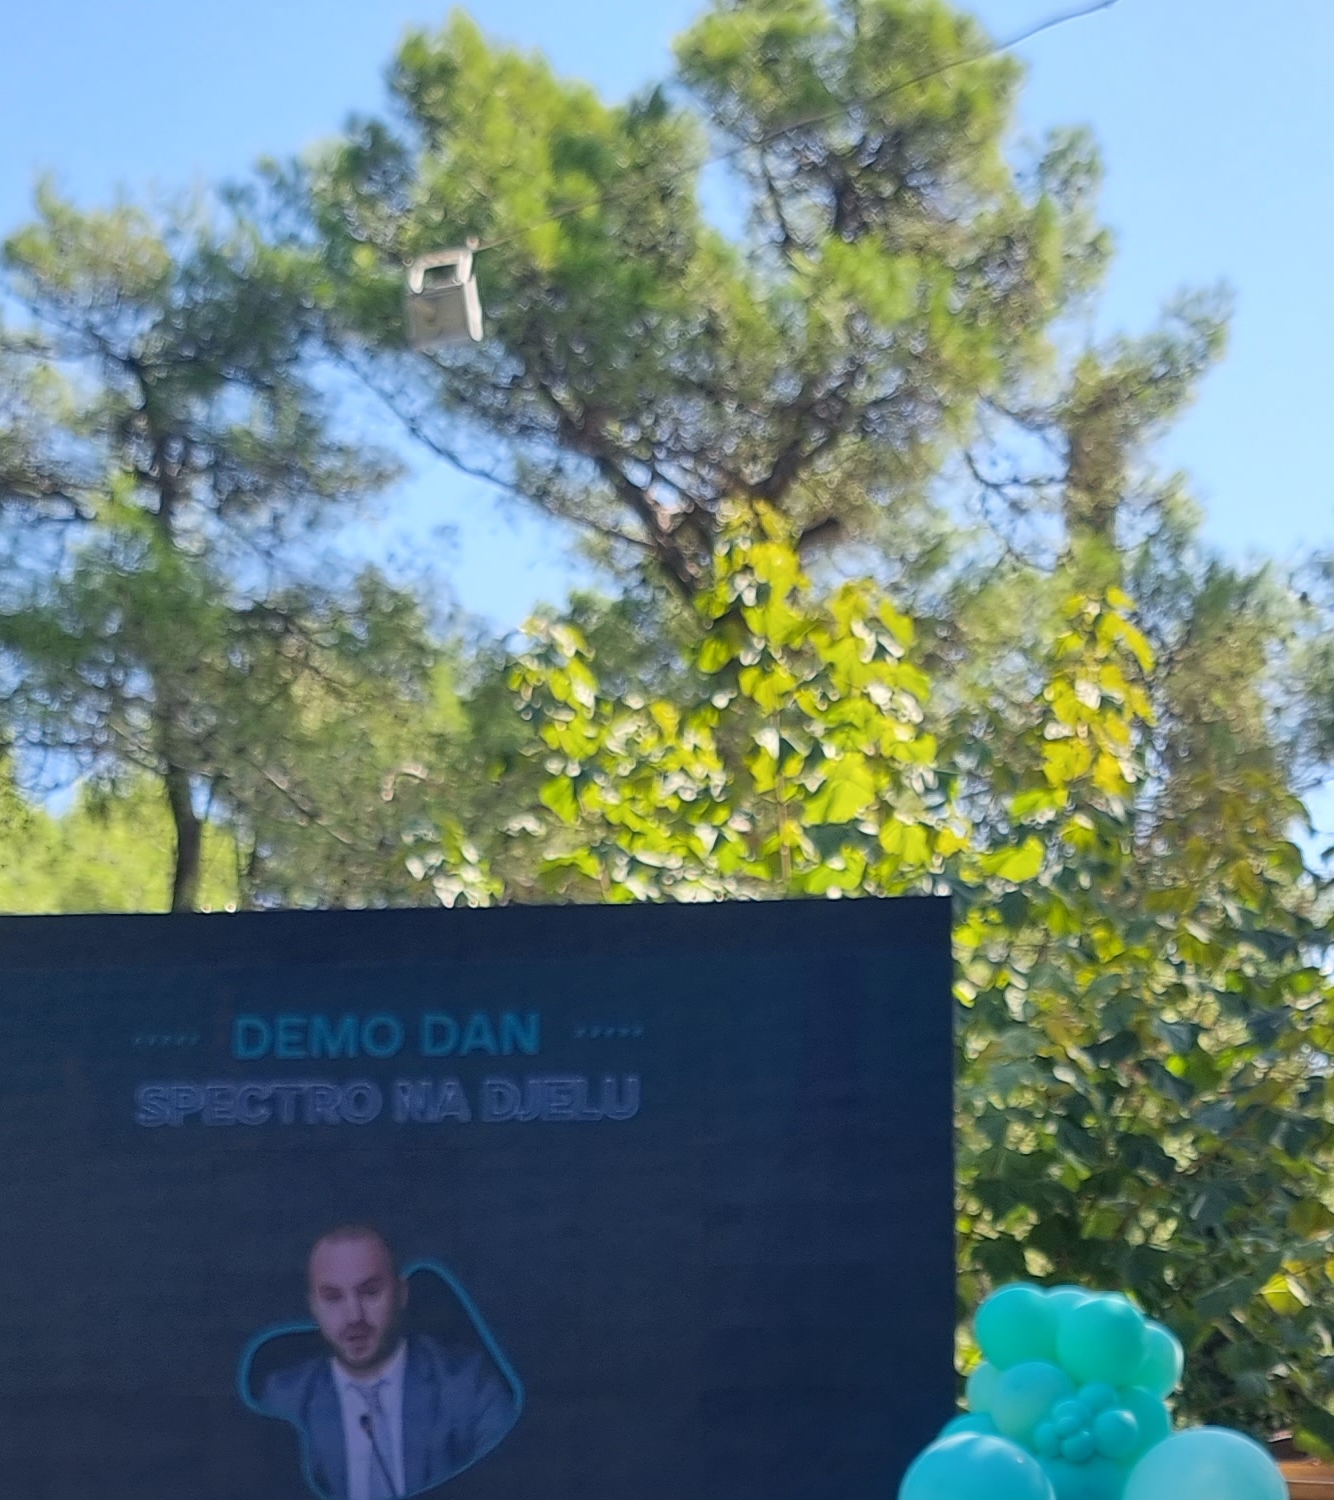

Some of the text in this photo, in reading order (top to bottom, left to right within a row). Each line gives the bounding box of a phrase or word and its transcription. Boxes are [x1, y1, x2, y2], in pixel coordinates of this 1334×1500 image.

[233, 1010, 542, 1061] DEMO DAN
[134, 1072, 642, 1127] SPECTRO NA DJELU
